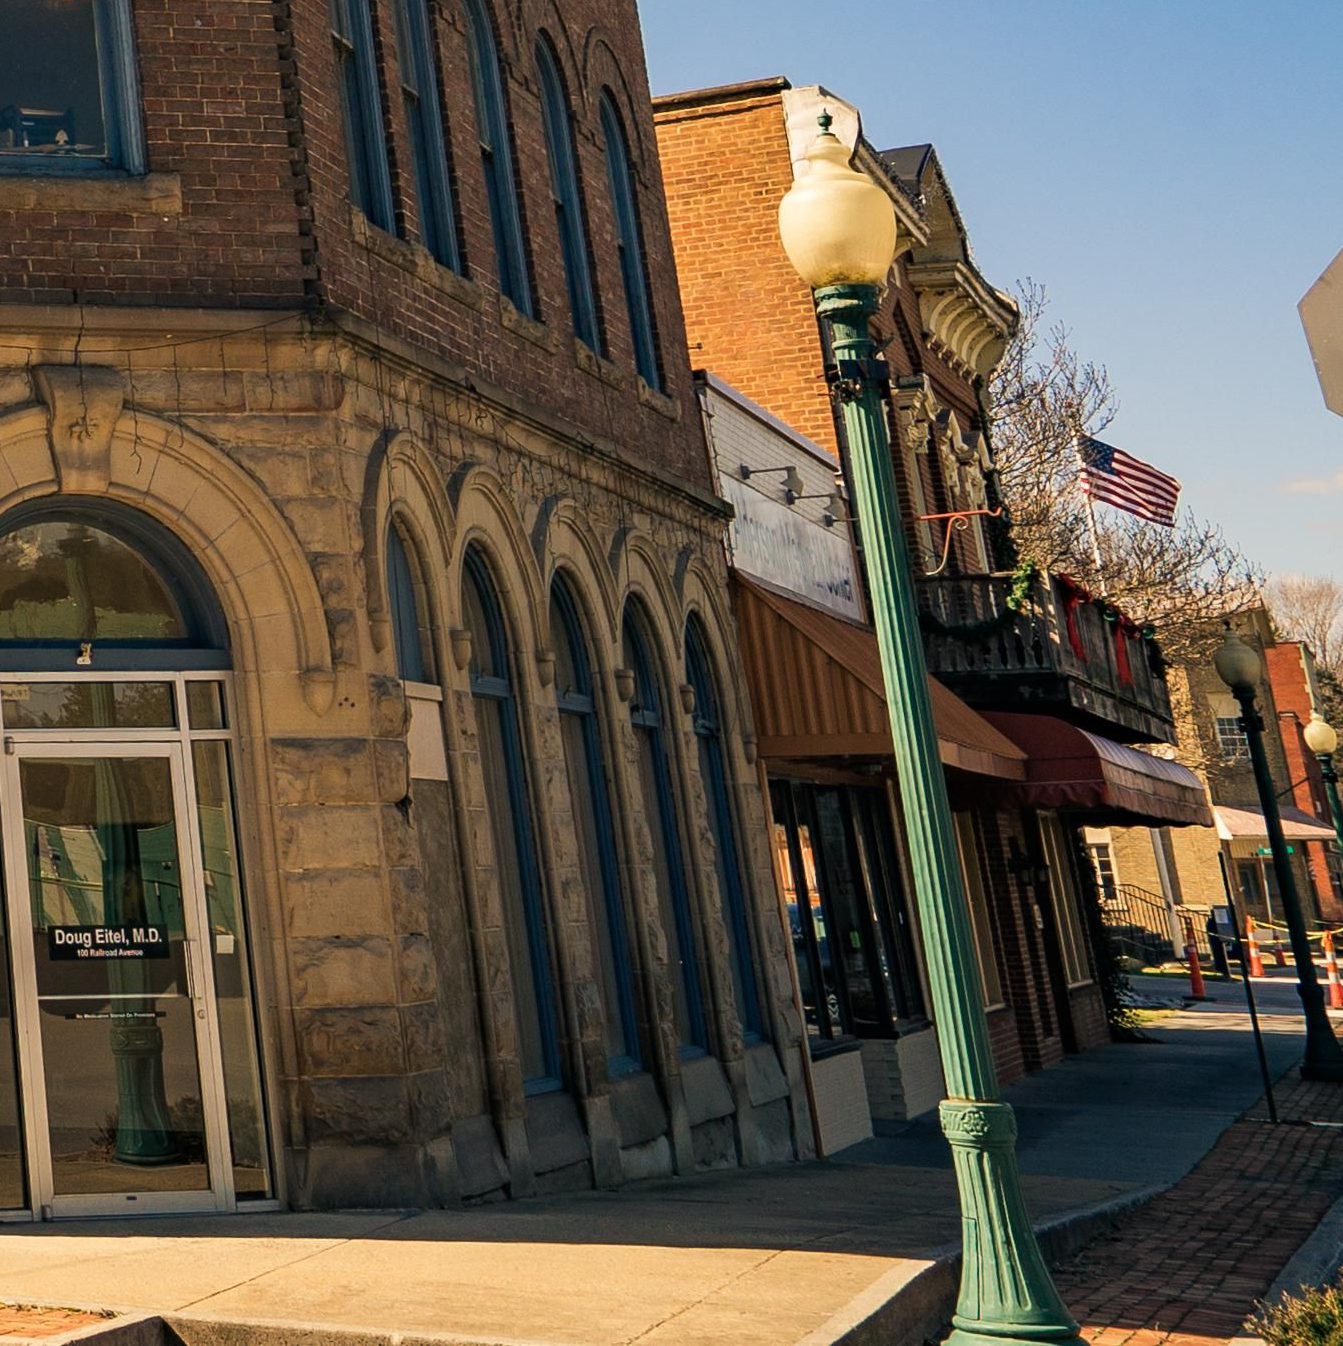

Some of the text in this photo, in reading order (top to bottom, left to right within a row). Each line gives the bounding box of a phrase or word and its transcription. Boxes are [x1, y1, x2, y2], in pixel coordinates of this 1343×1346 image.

[55, 928, 162, 947] Doug Eitel, M.D.
